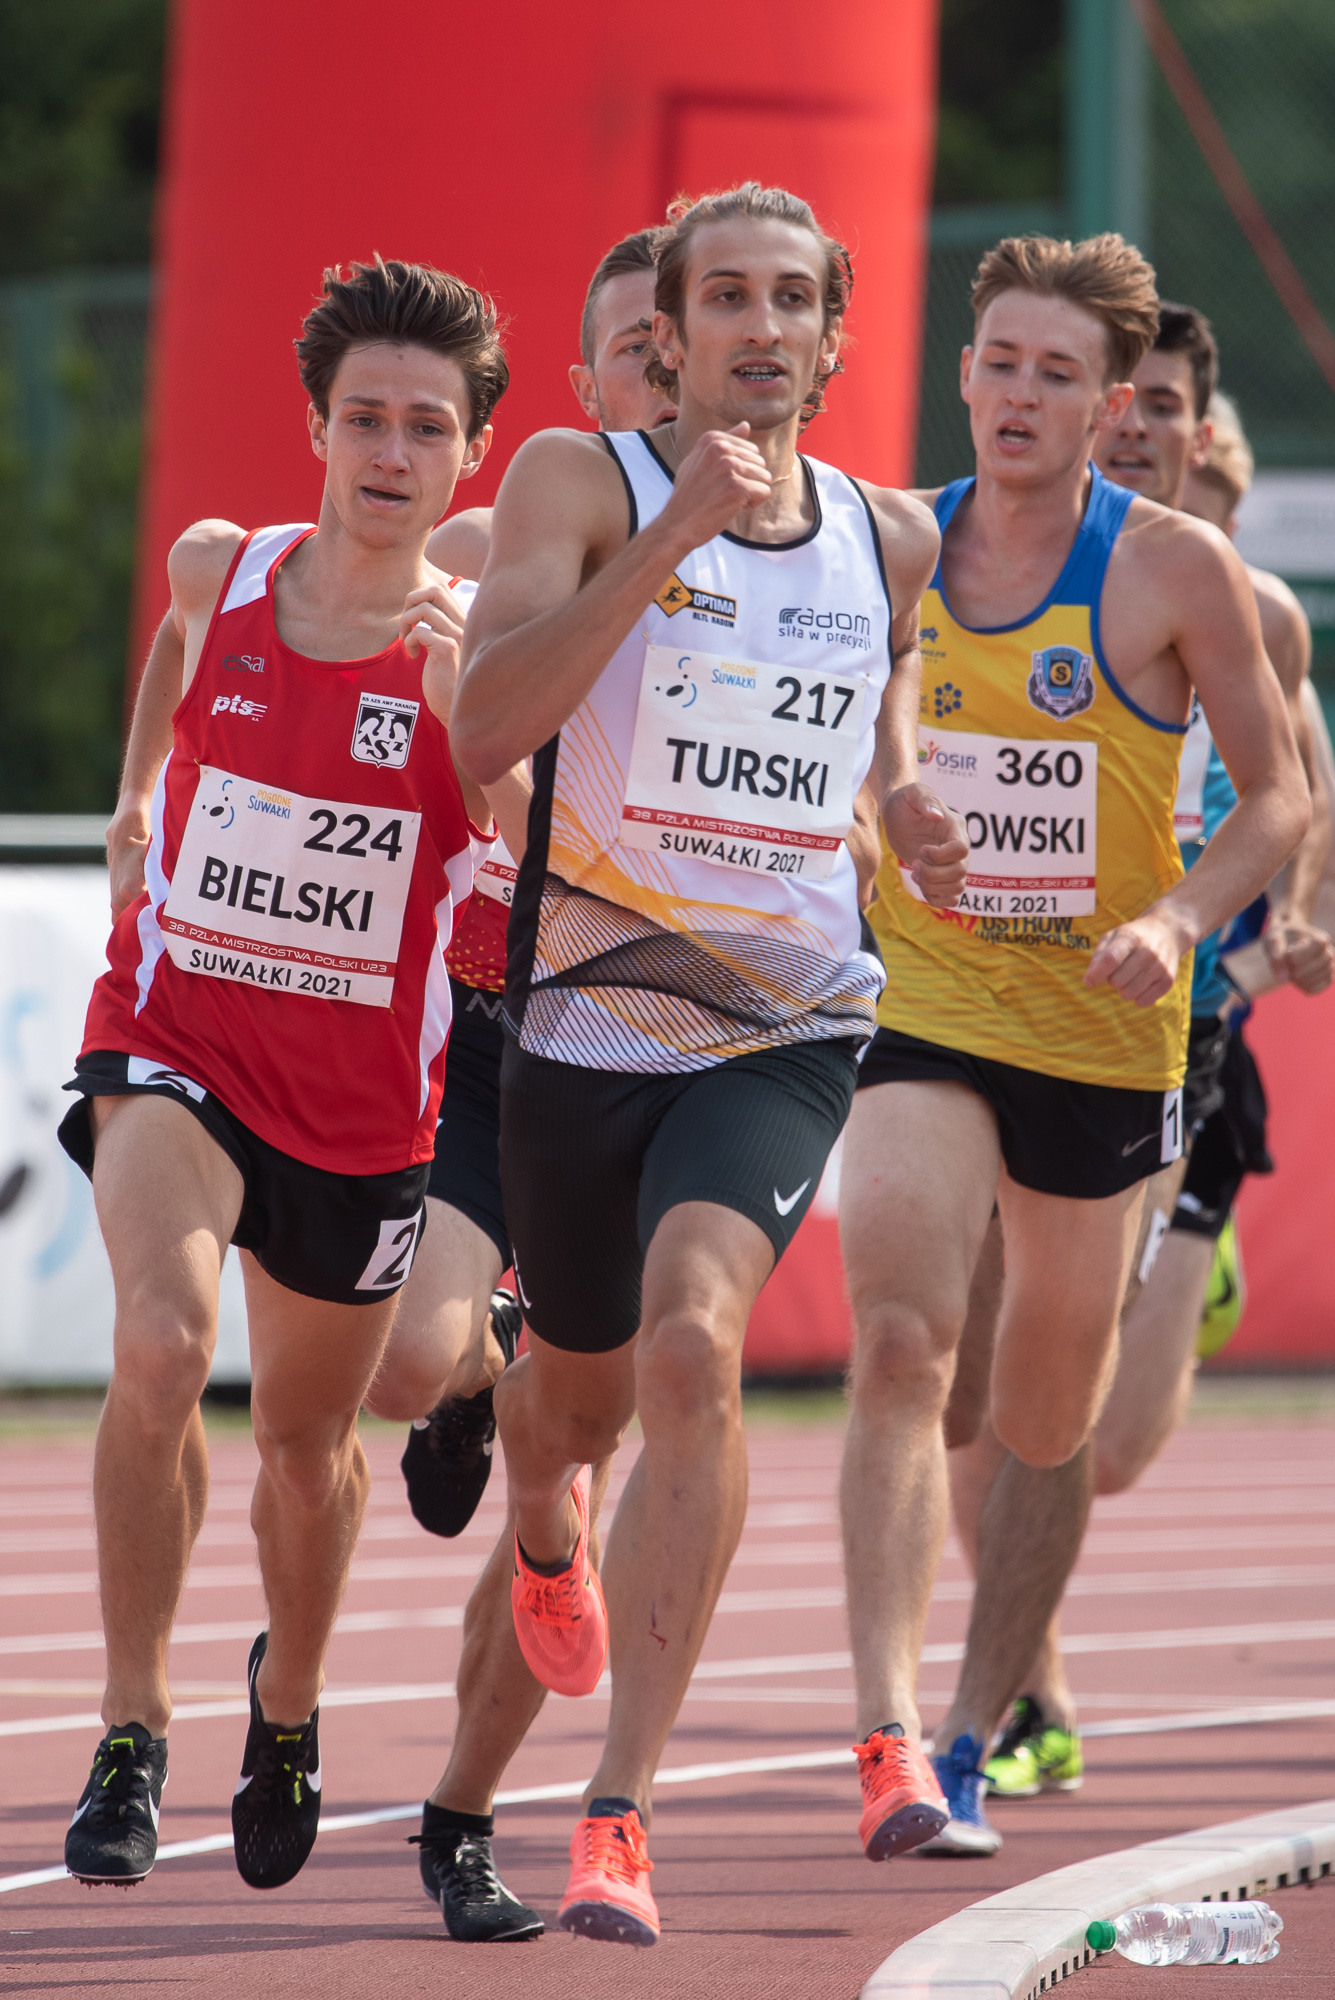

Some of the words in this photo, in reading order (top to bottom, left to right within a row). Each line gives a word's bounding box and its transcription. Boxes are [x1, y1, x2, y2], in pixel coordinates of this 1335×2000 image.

[693, 592, 735, 615] OPTIMA
[779, 626, 804, 639] siła
[809, 631, 820, 641] w
[827, 632, 872, 651] precyzji
[222, 654, 265, 673] esa
[721, 662, 757, 678] POGODNE
[211, 694, 262, 717] pts
[771, 676, 855, 730] 217
[666, 737, 829, 807] TURSKI
[936, 752, 977, 771] OSIR
[995, 747, 1083, 788] 360
[257, 789, 292, 808] POGODNE
[303, 808, 403, 862] 224
[656, 814, 690, 827] PZLA
[693, 819, 781, 841] MISTRZOSTWA
[783, 833, 816, 846] POLSKI
[950, 808, 1085, 854] OWSKI
[659, 832, 761, 868] SUWAŁKI
[766, 852, 805, 874] 2021
[198, 855, 374, 932] BIELSKI
[1020, 879, 1060, 889] POLSKI
[1063, 879, 1088, 888] U23
[1010, 897, 1057, 913] 2021
[168, 920, 187, 934] 38.
[189, 929, 220, 943] PZLA
[221, 937, 312, 962] MISTRZOSTWA
[314, 955, 358, 970] POLSKI
[361, 963, 388, 973] U23
[189, 949, 291, 987] SUWAŁKI
[298, 971, 352, 997] 2021
[1166, 1097, 1177, 1146] 1
[372, 1221, 416, 1286] 2
